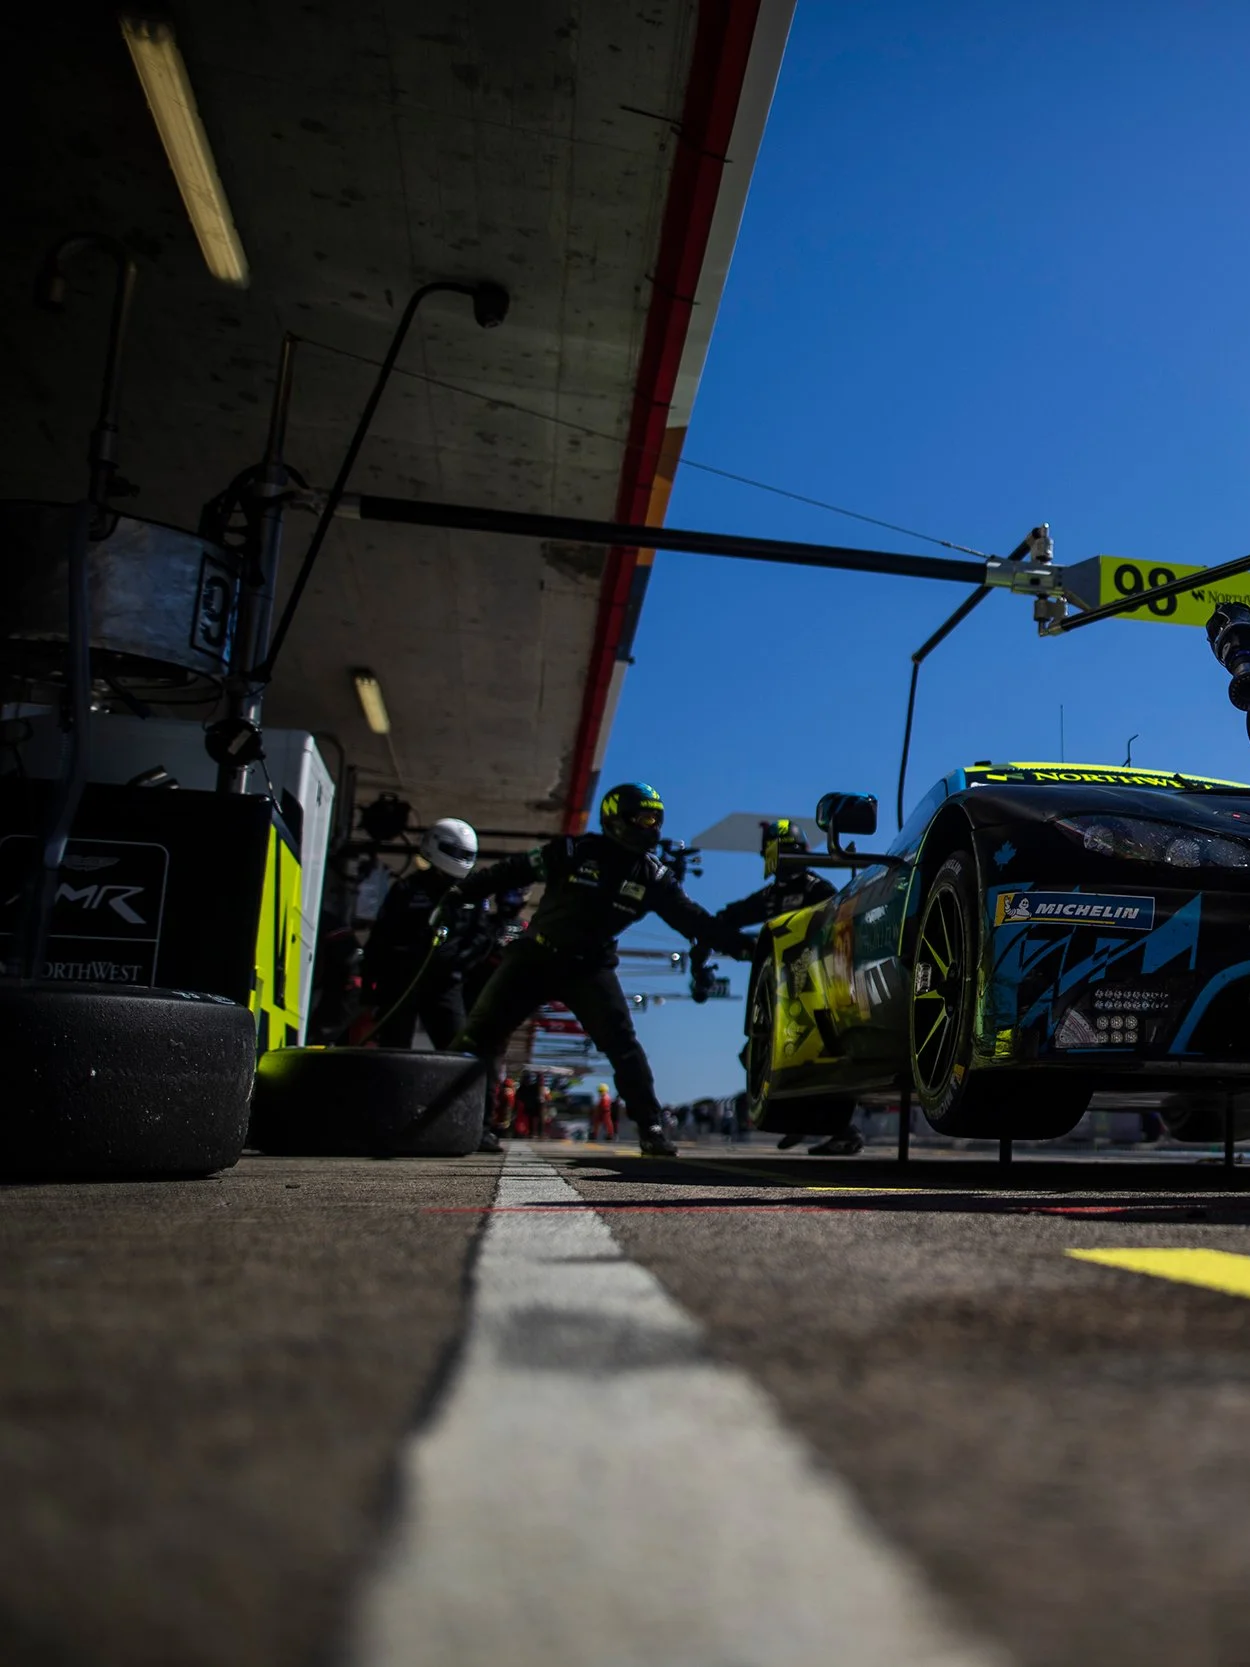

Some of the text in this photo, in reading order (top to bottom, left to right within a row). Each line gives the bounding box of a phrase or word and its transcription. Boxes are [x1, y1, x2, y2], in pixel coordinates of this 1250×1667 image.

[1114, 563, 1178, 616] 98
[4, 881, 148, 925] MR
[1035, 903, 1140, 920] MICHELIN
